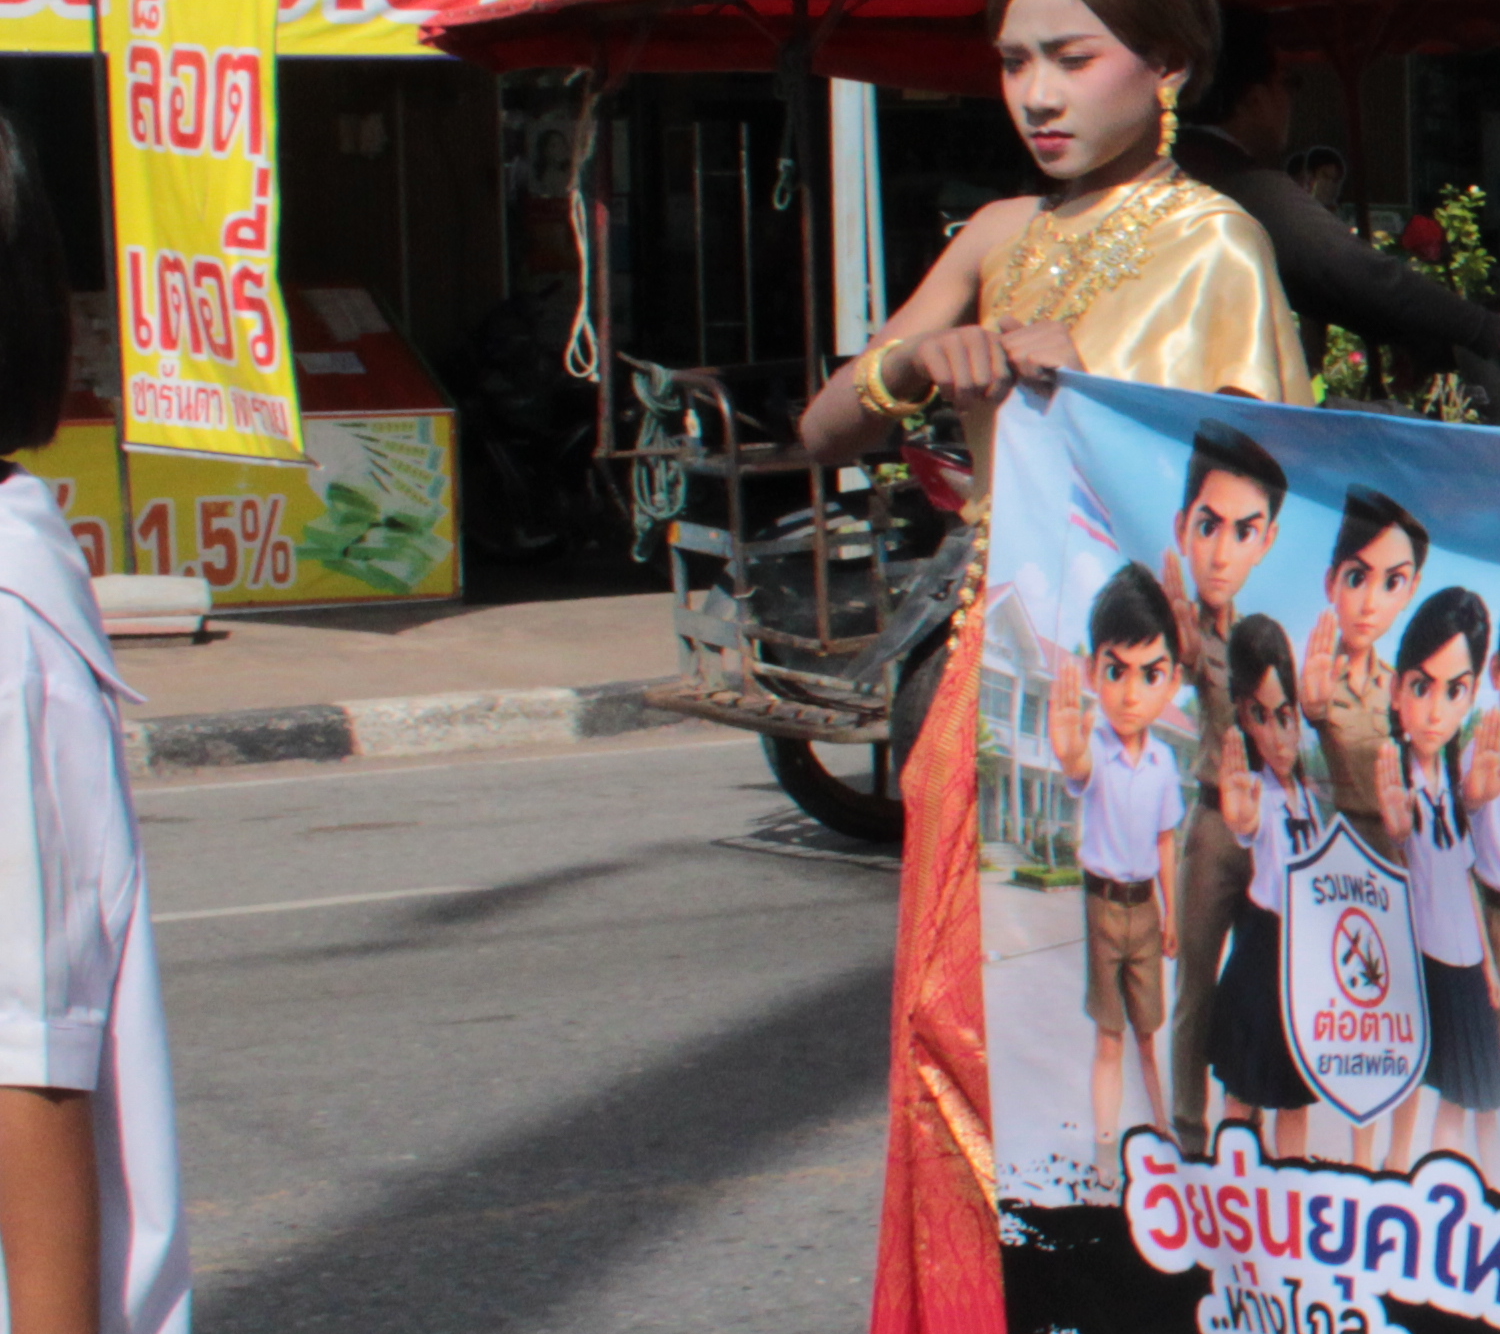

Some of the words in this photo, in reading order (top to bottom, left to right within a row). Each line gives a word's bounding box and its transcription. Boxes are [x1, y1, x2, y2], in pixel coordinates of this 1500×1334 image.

[128, 167, 277, 368] เตอรี่
[1311, 870, 1390, 913] รวมพลัง
